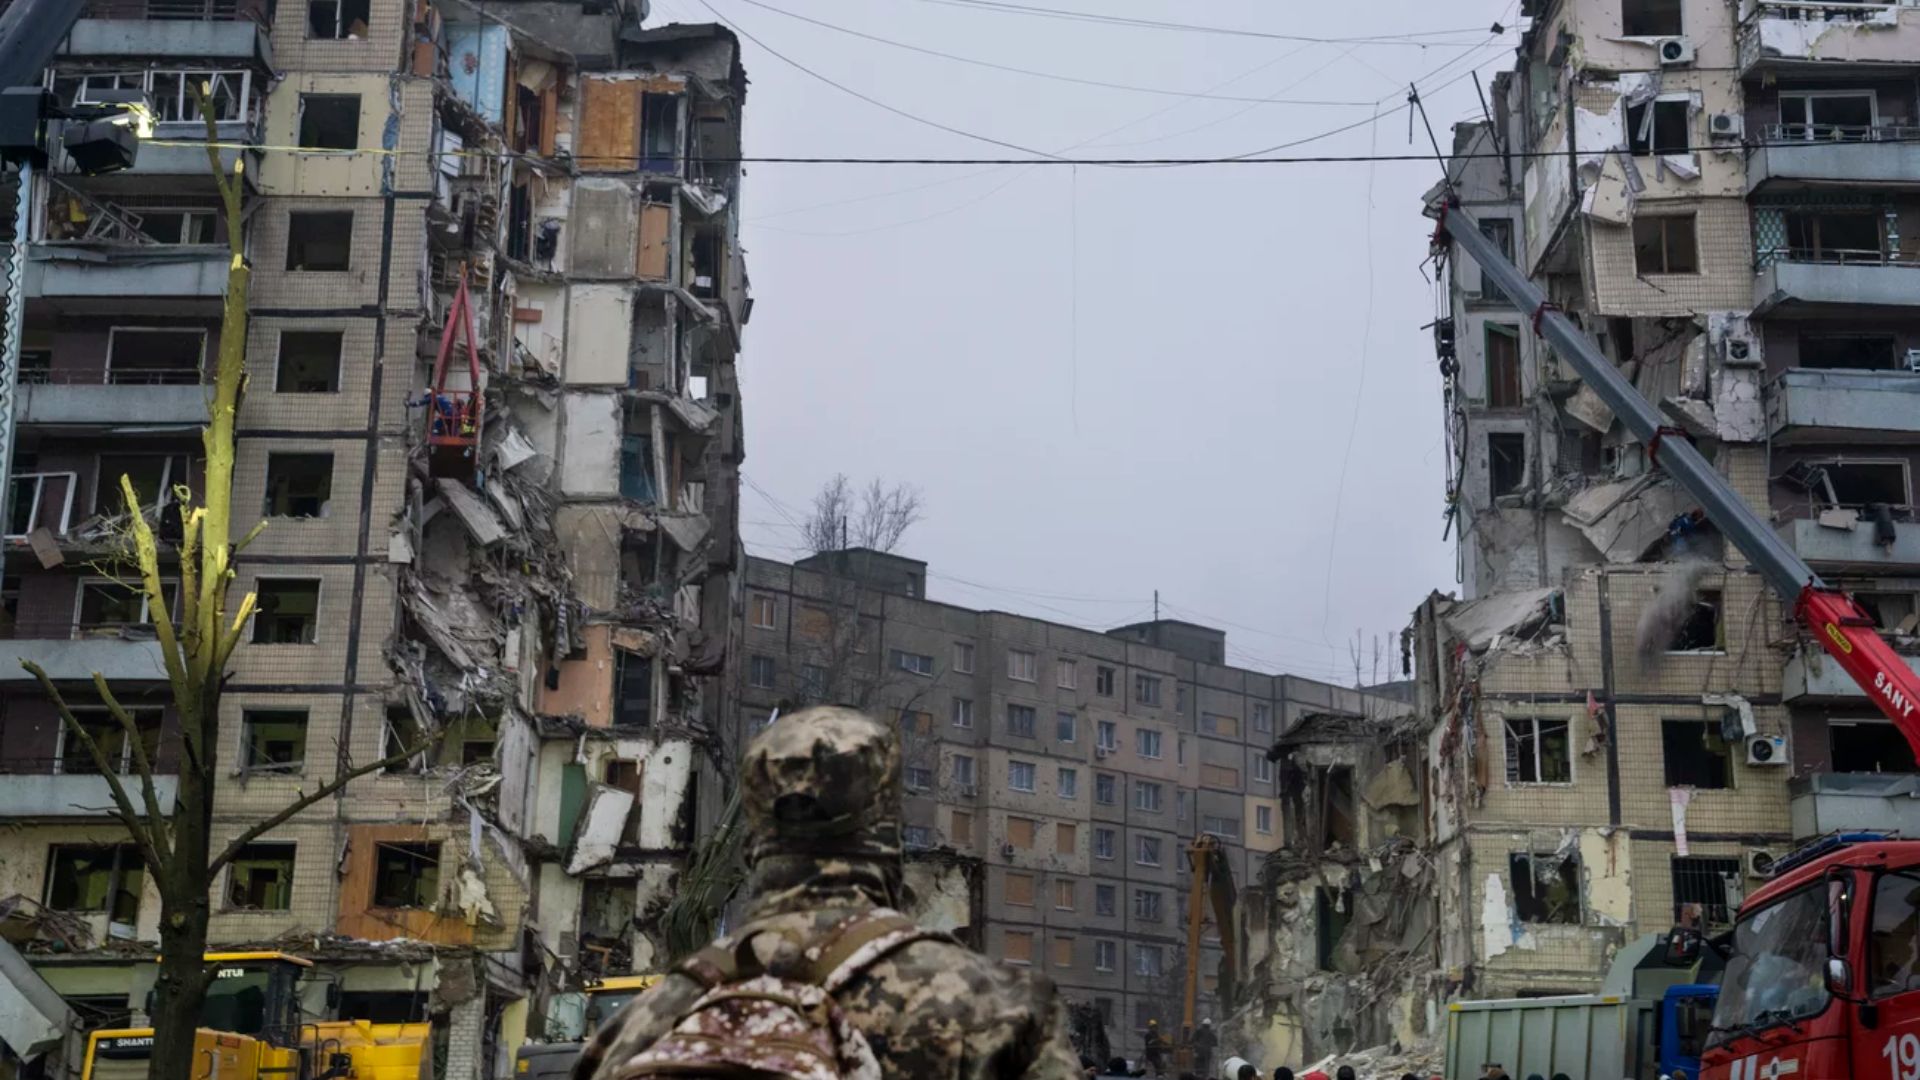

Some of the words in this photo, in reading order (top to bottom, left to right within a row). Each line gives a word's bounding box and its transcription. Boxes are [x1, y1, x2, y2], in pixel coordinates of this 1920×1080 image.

[1875, 671, 1914, 717] SANY
[216, 968, 244, 978] NTUI
[1882, 1033, 1920, 1080] 19
